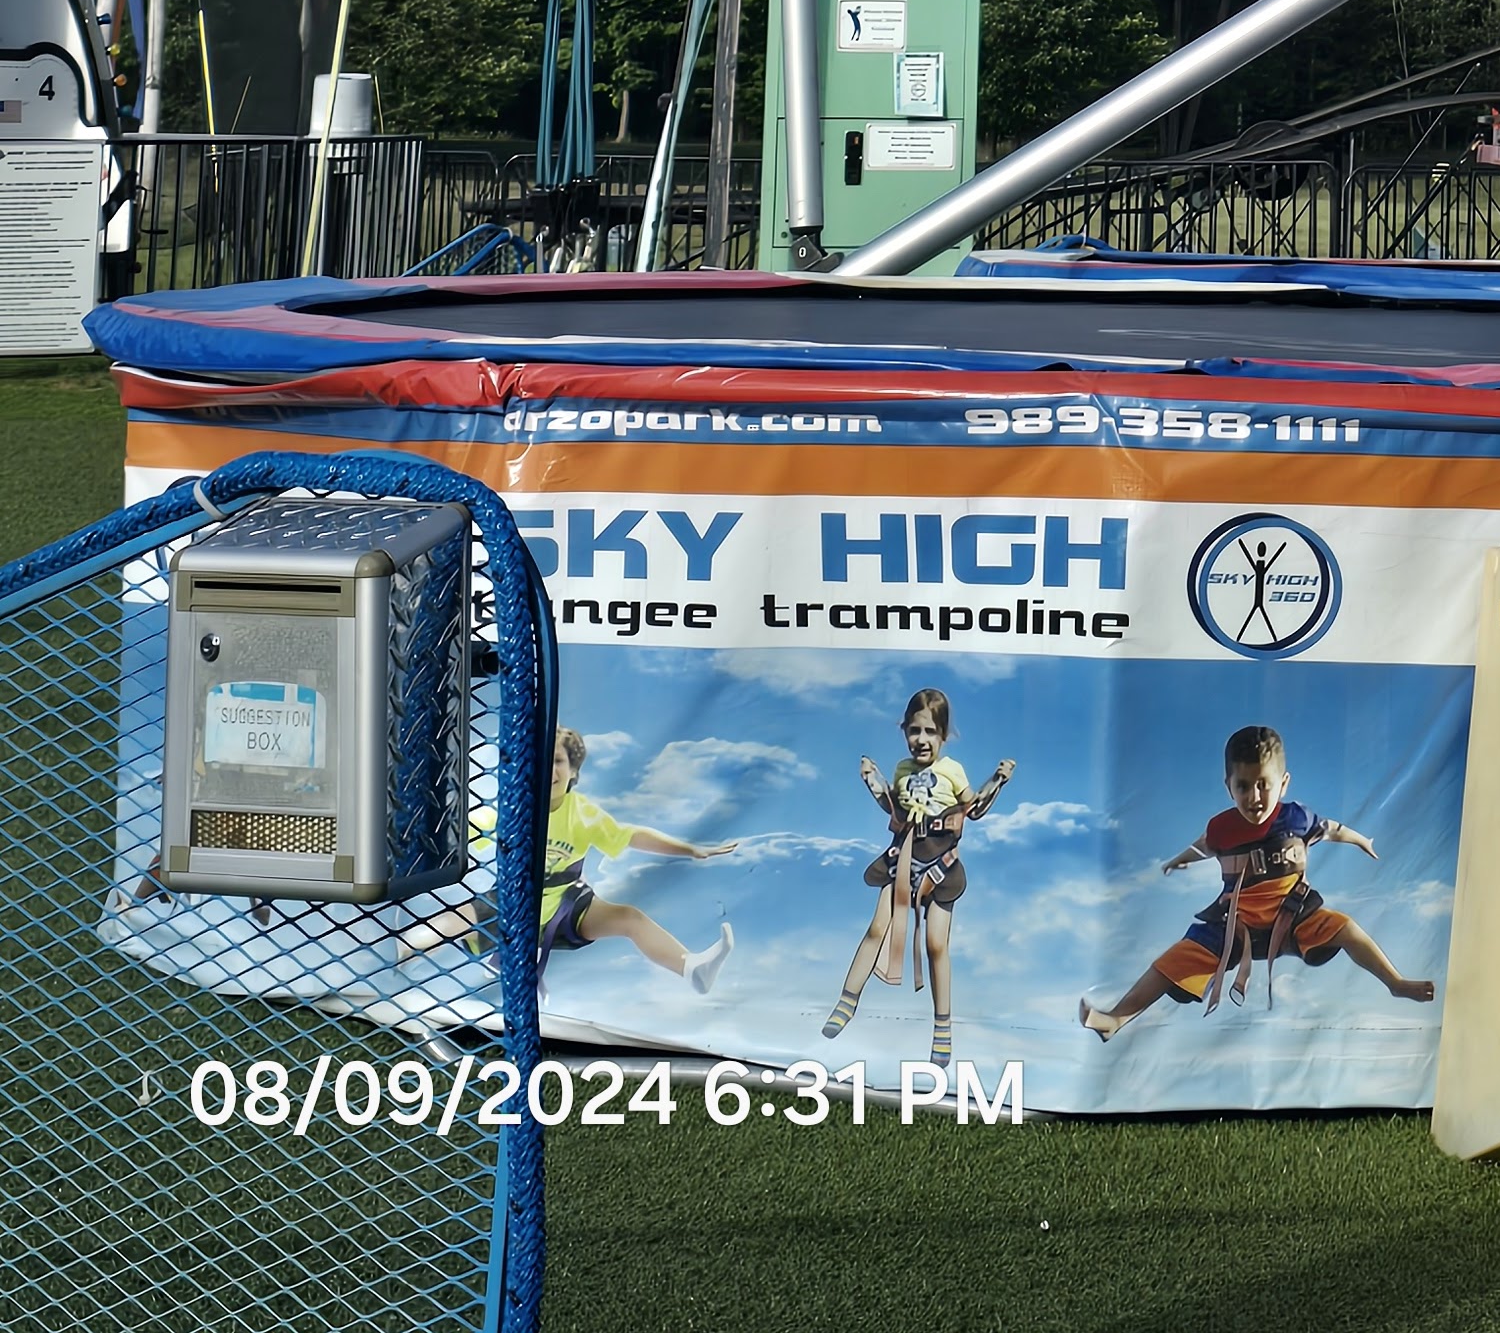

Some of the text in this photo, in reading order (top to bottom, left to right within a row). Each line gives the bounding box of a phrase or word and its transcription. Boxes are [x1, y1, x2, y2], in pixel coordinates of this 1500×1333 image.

[38, 74, 56, 102] 4
[964, 405, 1362, 443] 989-358-1111
[820, 512, 1129, 590] HIGH
[1207, 572, 1320, 587] SKY HIGH
[1268, 590, 1317, 603] 360
[760, 593, 1130, 641] trampoline
[220, 706, 311, 728] SUGGESTION
[247, 731, 282, 751] BOX
